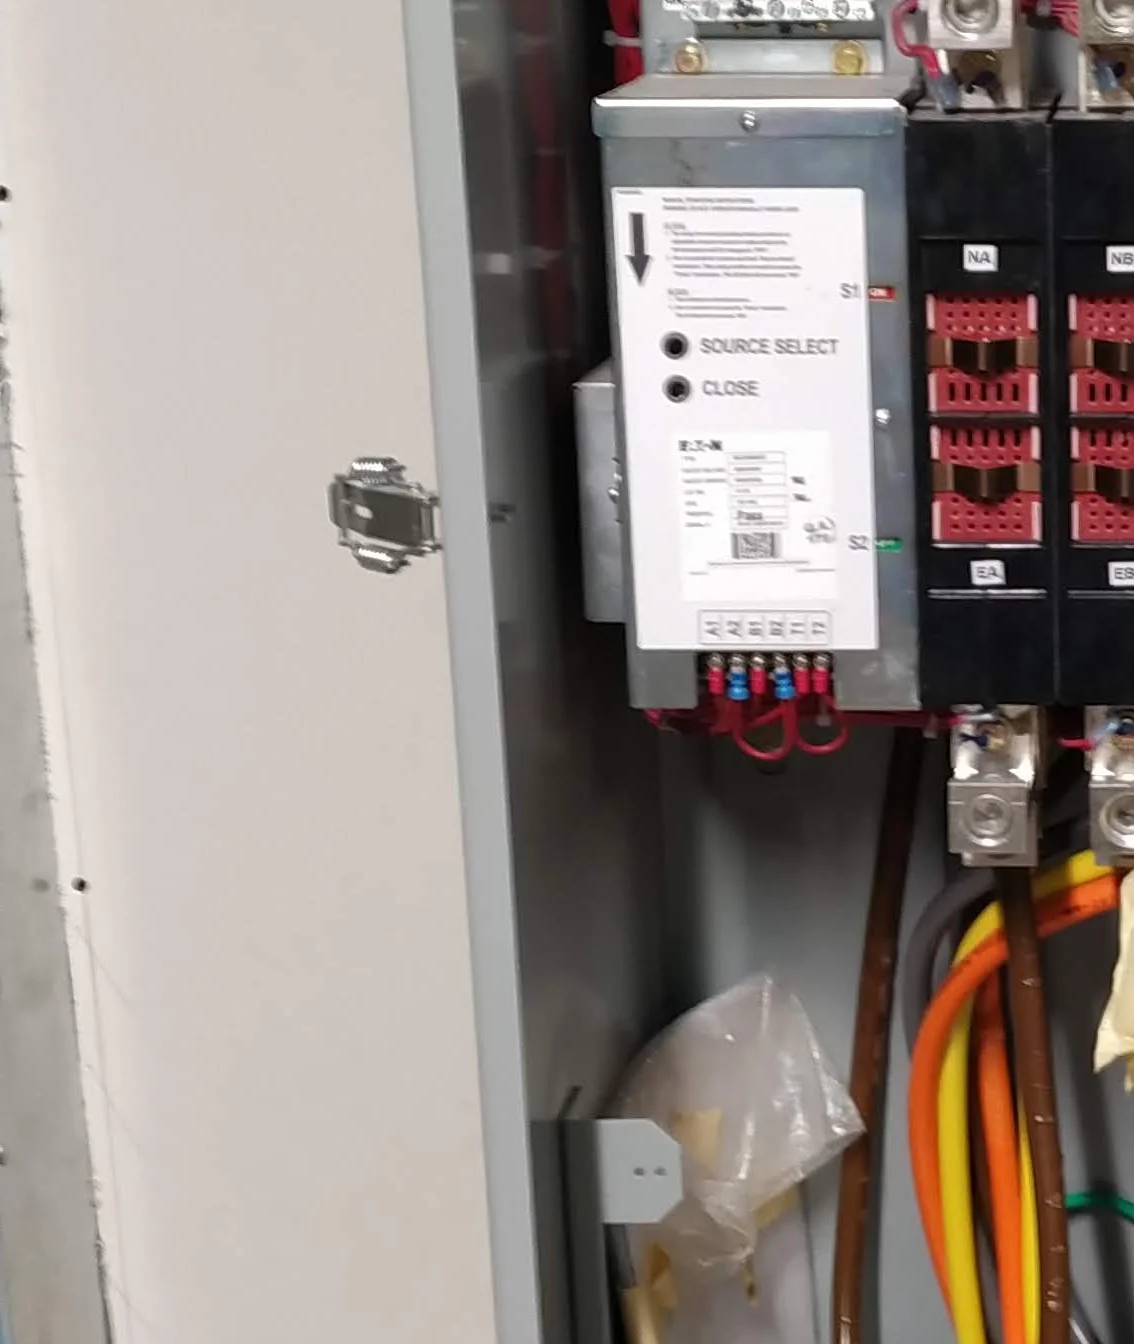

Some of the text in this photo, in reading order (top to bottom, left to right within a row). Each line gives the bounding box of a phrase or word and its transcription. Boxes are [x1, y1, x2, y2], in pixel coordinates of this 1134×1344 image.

[968, 250, 990, 265] NA
[1111, 252, 1134, 265] NB
[699, 338, 840, 356] SOURCE SELECT
[702, 379, 760, 398] CLOSE
[848, 534, 870, 551] S2
[976, 565, 999, 579] EA
